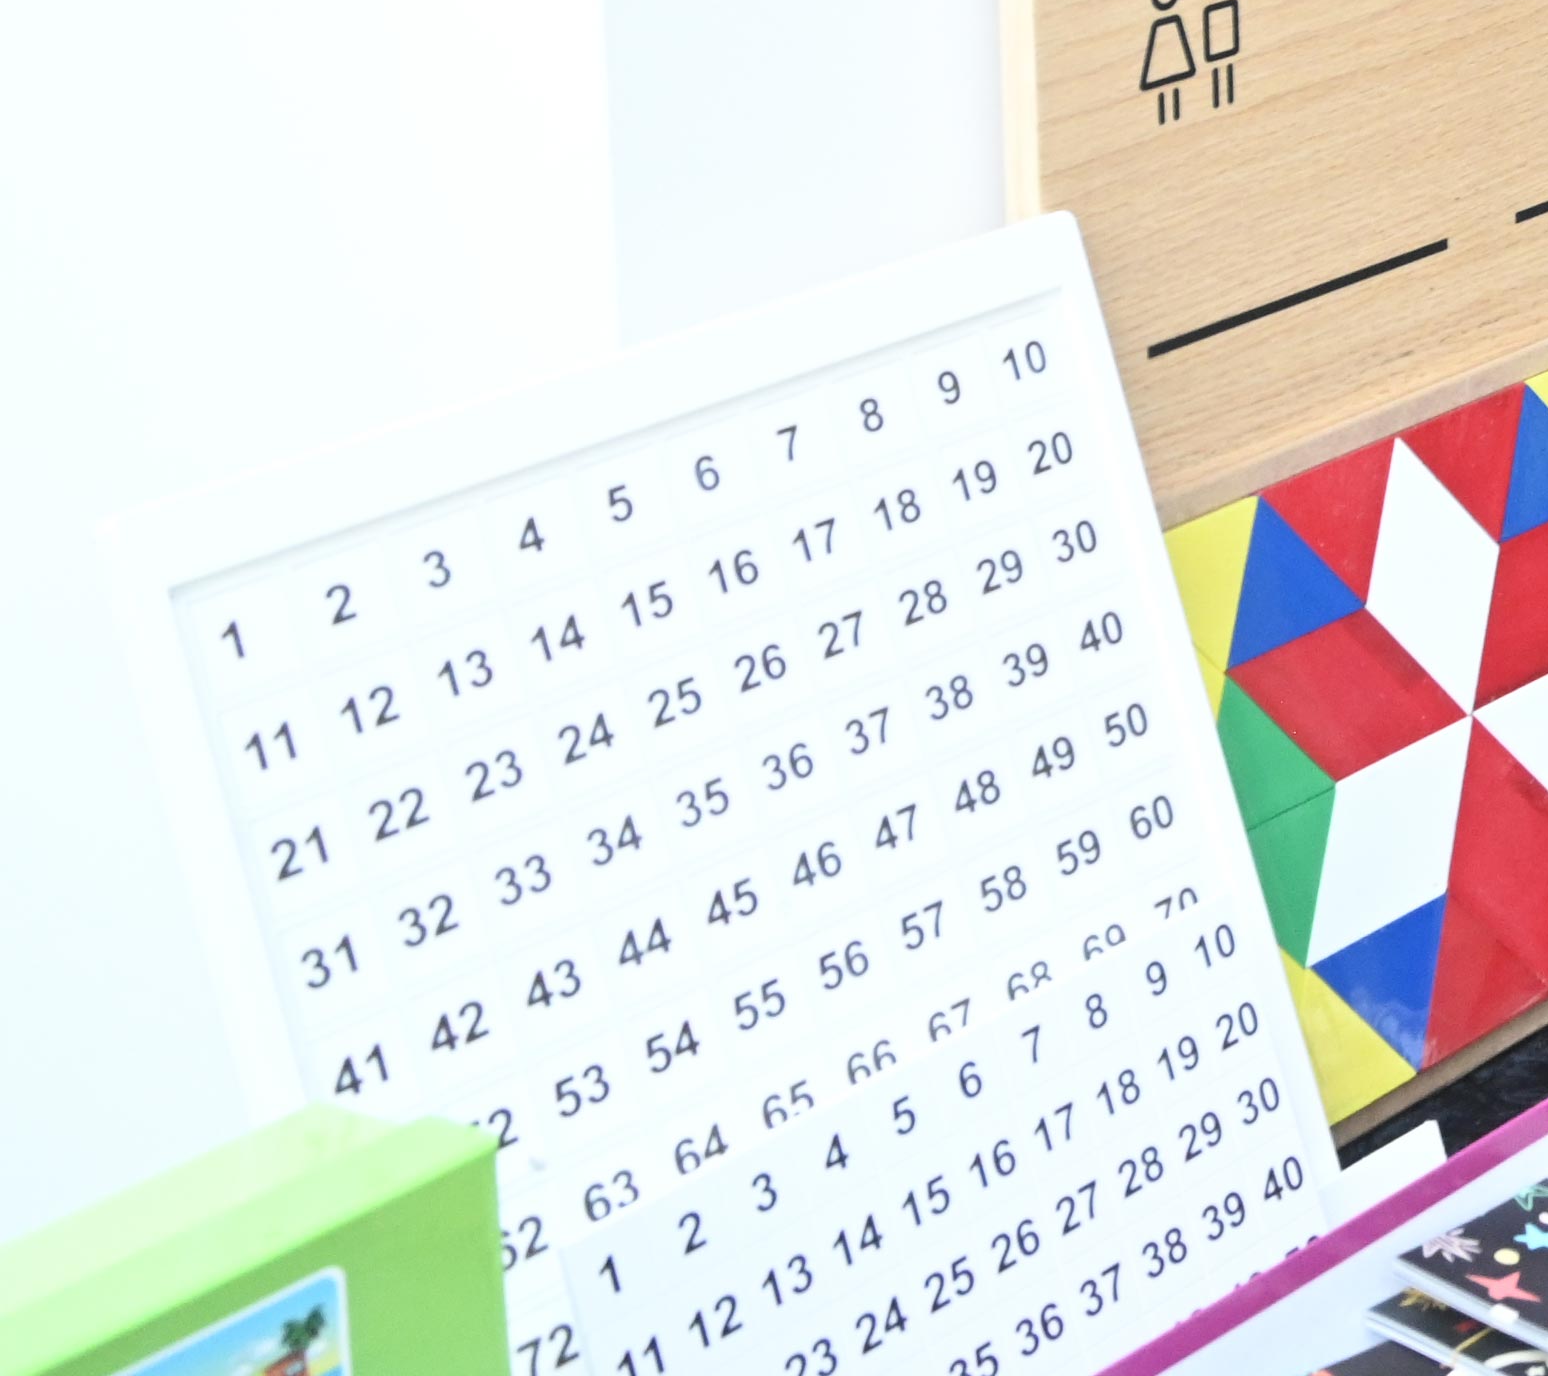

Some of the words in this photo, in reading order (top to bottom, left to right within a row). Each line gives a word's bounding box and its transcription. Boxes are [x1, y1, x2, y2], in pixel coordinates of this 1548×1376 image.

[222, 621, 245, 658] 1
[326, 584, 357, 625] 2
[423, 550, 451, 588] 3
[519, 517, 545, 552] 4
[608, 484, 633, 522] 5
[695, 455, 720, 491] 6
[777, 425, 797, 461] 7
[859, 398, 884, 432] 8
[938, 371, 960, 405] 9
[1003, 341, 1046, 380] 10
[245, 721, 296, 770] 11
[341, 686, 400, 734] 12
[438, 650, 493, 696] 13
[531, 614, 585, 662] 14
[621, 580, 673, 627] 15
[709, 549, 759, 594] 16
[793, 517, 835, 562] 17
[874, 489, 921, 531] 18
[953, 460, 997, 501] 19
[1027, 432, 1072, 475] 20
[271, 825, 328, 882] 21
[368, 787, 430, 842] 22
[465, 750, 523, 802] 23
[558, 713, 614, 765] 24
[648, 677, 701, 728] 25
[734, 644, 786, 693] 26
[818, 610, 862, 659] 27
[899, 580, 947, 626] 28
[976, 550, 1023, 595] 29
[1052, 520, 1097, 563] 30
[301, 934, 358, 989] 31
[398, 894, 459, 947] 32
[495, 854, 551, 906] 33
[587, 815, 642, 866] 34
[676, 777, 729, 827] 35
[762, 743, 813, 790] 36
[845, 706, 888, 755] 37
[925, 675, 973, 720] 38
[1003, 643, 1048, 687] 39
[1080, 611, 1123, 651] 40
[334, 1043, 388, 1095] 41
[431, 1001, 489, 1051] 42
[527, 959, 581, 1007] 43
[619, 917, 671, 965] 44
[708, 878, 758, 925] 45
[793, 841, 841, 886] 46
[876, 803, 916, 849] 47
[955, 770, 1000, 812] 48
[1032, 736, 1075, 778] 49
[1104, 703, 1148, 747] 50
[555, 1064, 610, 1118] 53
[646, 1020, 700, 1073] 54
[734, 978, 785, 1030] 55
[819, 940, 869, 990] 56
[901, 900, 943, 950] 57
[980, 865, 1027, 912] 58
[1056, 830, 1100, 876] 59
[1130, 795, 1173, 840] 60
[584, 1170, 639, 1222] 63
[675, 1123, 728, 1175] 64
[763, 1080, 814, 1129] 65
[599, 1254, 621, 1293] 1
[678, 1211, 707, 1255] 2
[752, 1173, 777, 1212] 3
[825, 1133, 849, 1169] 4
[893, 1095, 916, 1135] 5
[959, 1061, 982, 1098] 6
[1021, 1024, 1040, 1063] 7
[1085, 993, 1108, 1029] 8
[1146, 961, 1167, 996] 9
[1195, 924, 1235, 968] 10
[617, 1336, 665, 1376] 11
[689, 1294, 743, 1348] 12
[762, 1254, 813, 1306] 13
[833, 1214, 883, 1266] 14
[902, 1175, 950, 1226] 15
[969, 1139, 1016, 1188] 16
[1034, 1102, 1073, 1151] 17
[1097, 1069, 1140, 1115] 18
[1157, 1035, 1199, 1080] 19
[1216, 1002, 1258, 1051] 20
[855, 1296, 908, 1355] 24
[924, 1255, 975, 1314] 25
[991, 1219, 1040, 1274] 26
[1056, 1180, 1096, 1236] 27
[1118, 1146, 1164, 1198] 28
[1178, 1112, 1222, 1162] 29
[1237, 1077, 1279, 1125] 30
[1016, 1303, 1064, 1357] 36
[1080, 1262, 1120, 1317] 37
[1142, 1227, 1187, 1278] 38
[1202, 1192, 1245, 1241] 39
[1264, 1156, 1303, 1201] 40
[518, 1324, 580, 1376] 72
